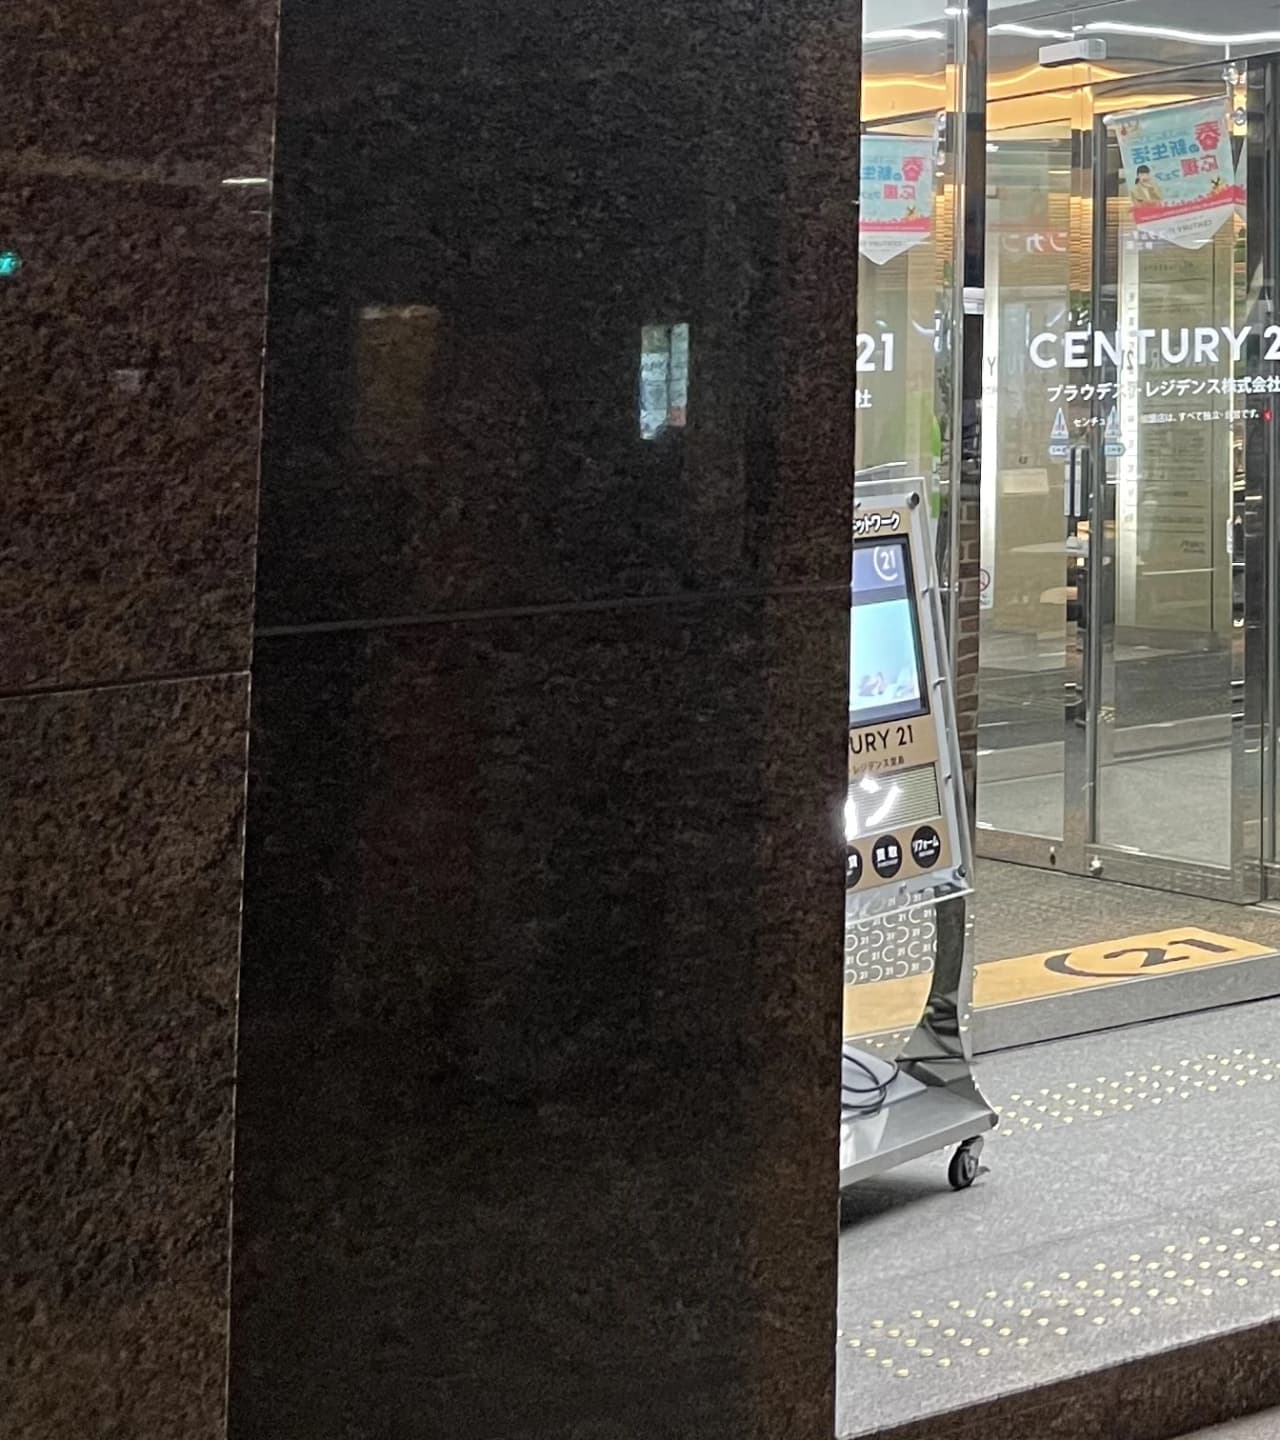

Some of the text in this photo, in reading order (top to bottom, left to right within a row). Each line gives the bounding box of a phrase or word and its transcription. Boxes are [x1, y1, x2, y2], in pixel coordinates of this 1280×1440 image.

[856, 332, 895, 372] 21
[1030, 326, 1252, 369] CENTURY
[896, 725, 914, 747] 21
[1103, 938, 1235, 969] 21
